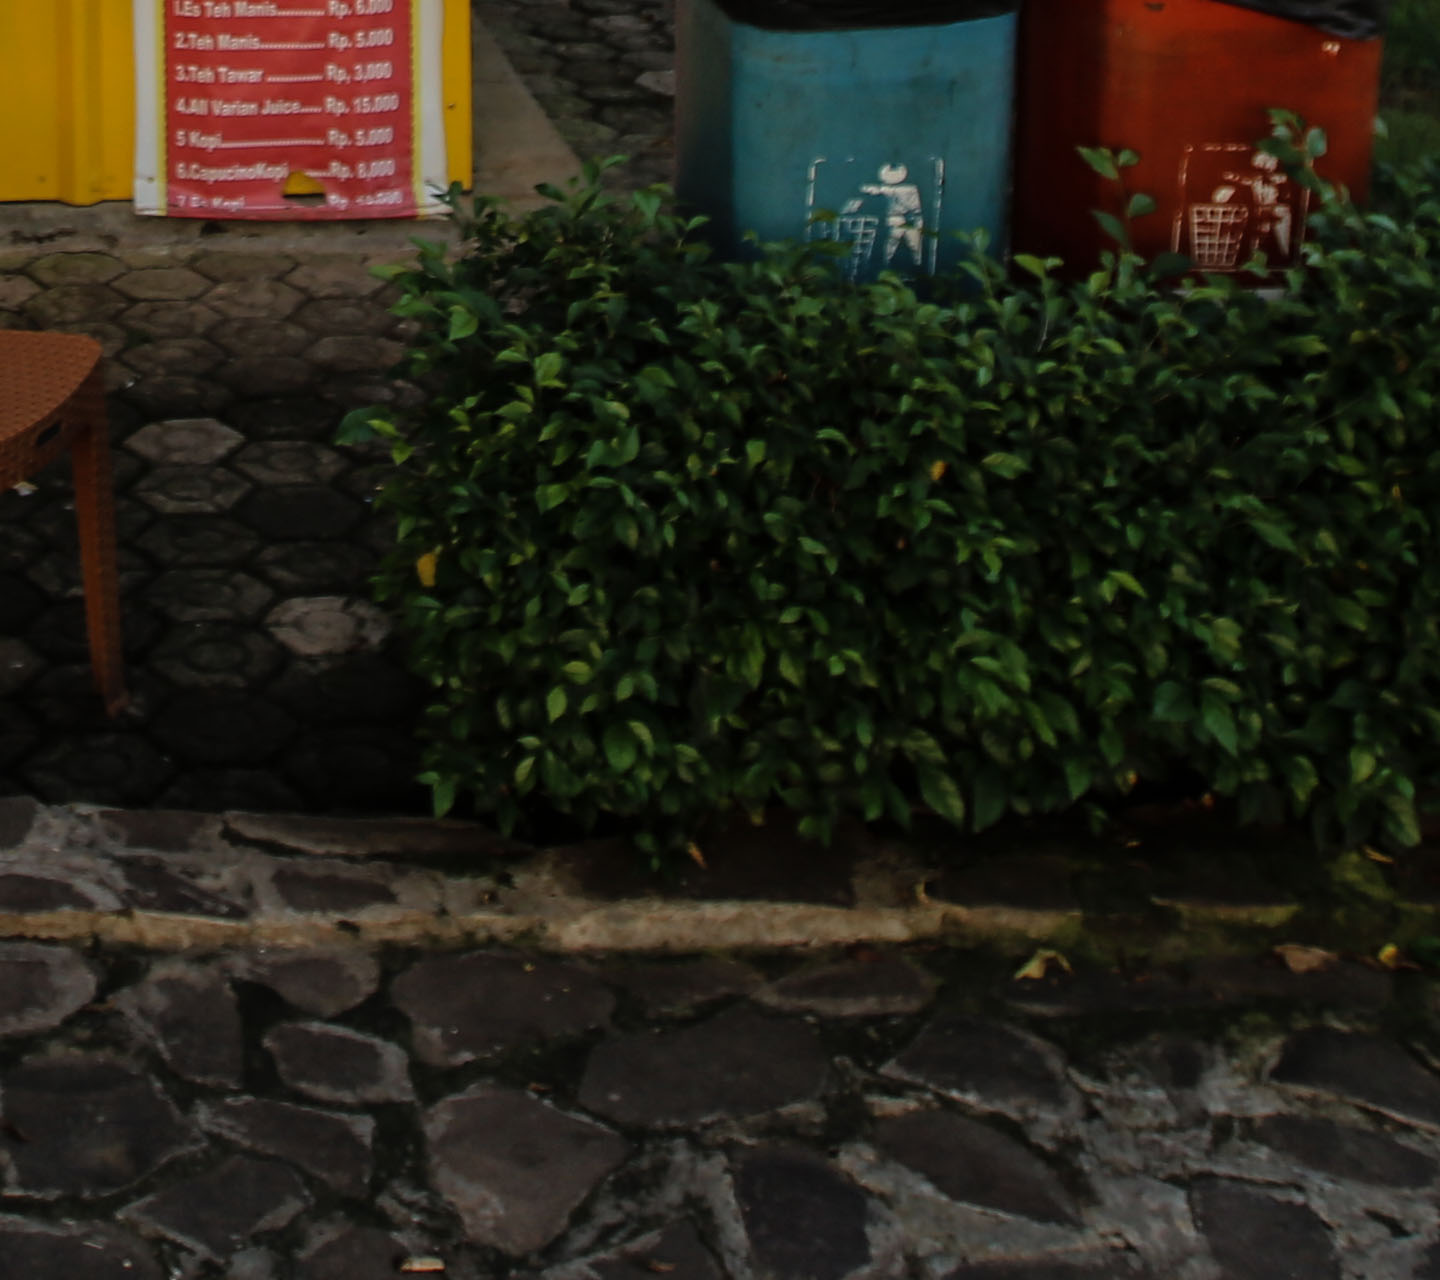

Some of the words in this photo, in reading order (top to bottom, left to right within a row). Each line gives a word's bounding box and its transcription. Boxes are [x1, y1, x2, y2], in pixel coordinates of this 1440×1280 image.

[203, 0, 232, 17] Teh
[216, 66, 264, 83] Tawar
[211, 97, 259, 116] Varian
[352, 94, 400, 113] 15.000
